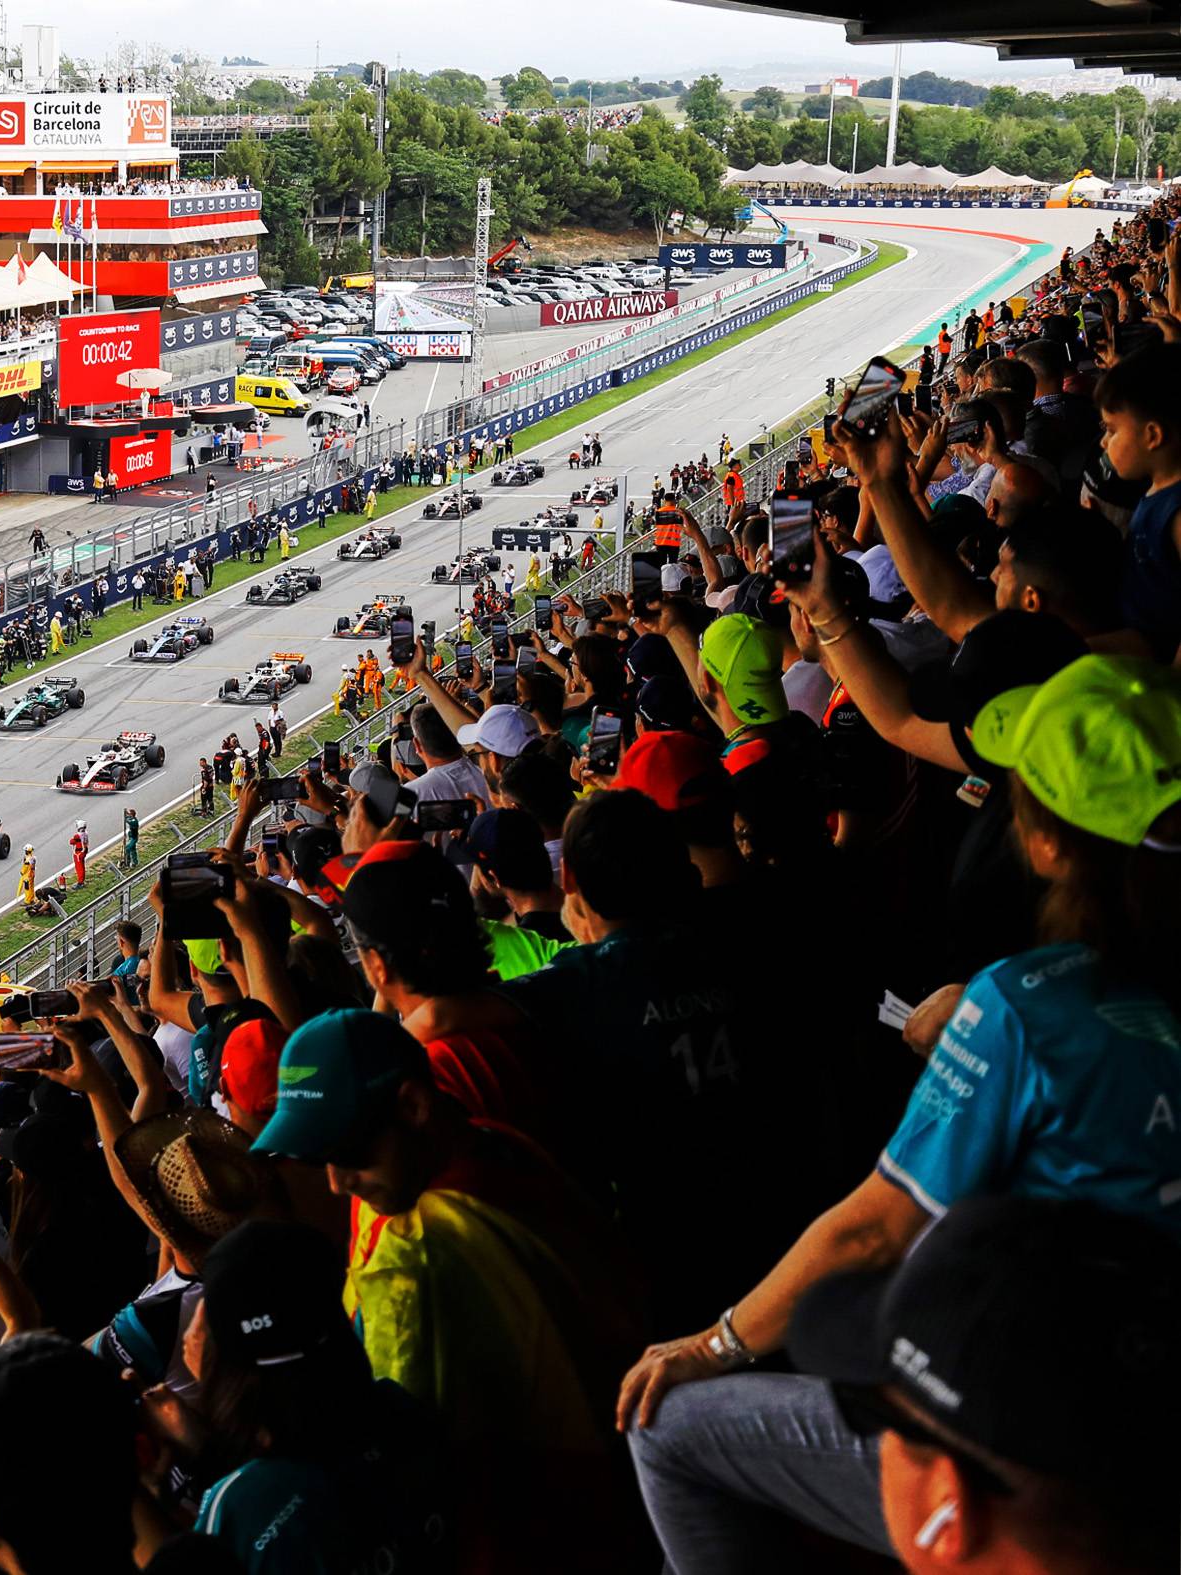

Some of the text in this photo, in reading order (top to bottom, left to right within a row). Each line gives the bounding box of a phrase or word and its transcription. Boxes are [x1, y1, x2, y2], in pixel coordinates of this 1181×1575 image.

[34, 101, 102, 116] Circuit de
[33, 118, 101, 130] Barcelona
[33, 133, 102, 146] CATALUNYA
[672, 248, 771, 259] aws aws aws
[554, 293, 666, 324] QATAR AIRWAYS
[79, 326, 116, 336] COUNTDOWN
[386, 336, 418, 346] LIQUI
[429, 335, 460, 346] LIQUI
[82, 340, 133, 365] 00:00:42
[429, 346, 460, 356] MOLY
[238, 384, 253, 393] RACC
[126, 450, 154, 472] 00:00:43
[67, 478, 84, 487] aws
[738, 698, 768, 720] 14
[836, 710, 858, 720] aws
[642, 984, 728, 1026] ALONS
[670, 1024, 740, 1096] 14
